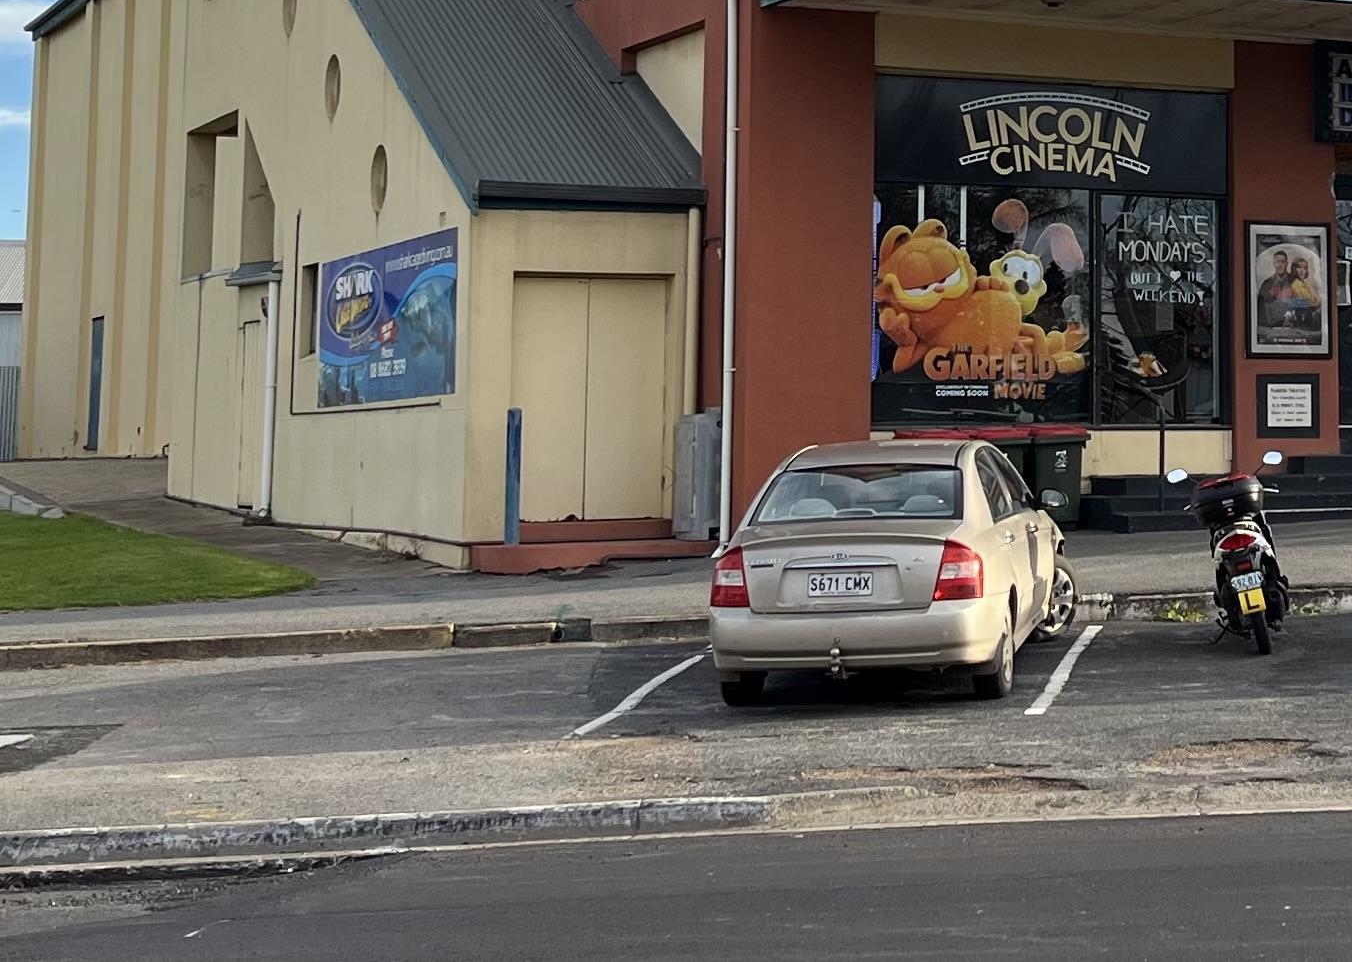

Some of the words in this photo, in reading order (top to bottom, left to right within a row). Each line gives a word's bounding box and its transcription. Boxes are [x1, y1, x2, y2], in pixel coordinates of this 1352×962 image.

[1336, 58, 1352, 79] A
[962, 104, 1146, 158] LINCOLN
[989, 143, 1117, 182] CINEMA
[1117, 212, 1136, 233] I
[1147, 212, 1209, 235] HATE
[923, 346, 1057, 381] GARFIELD
[993, 382, 1048, 400] MOVIE
[810, 576, 840, 592] S671
[845, 575, 871, 590] CMX
[1244, 593, 1261, 611] L
